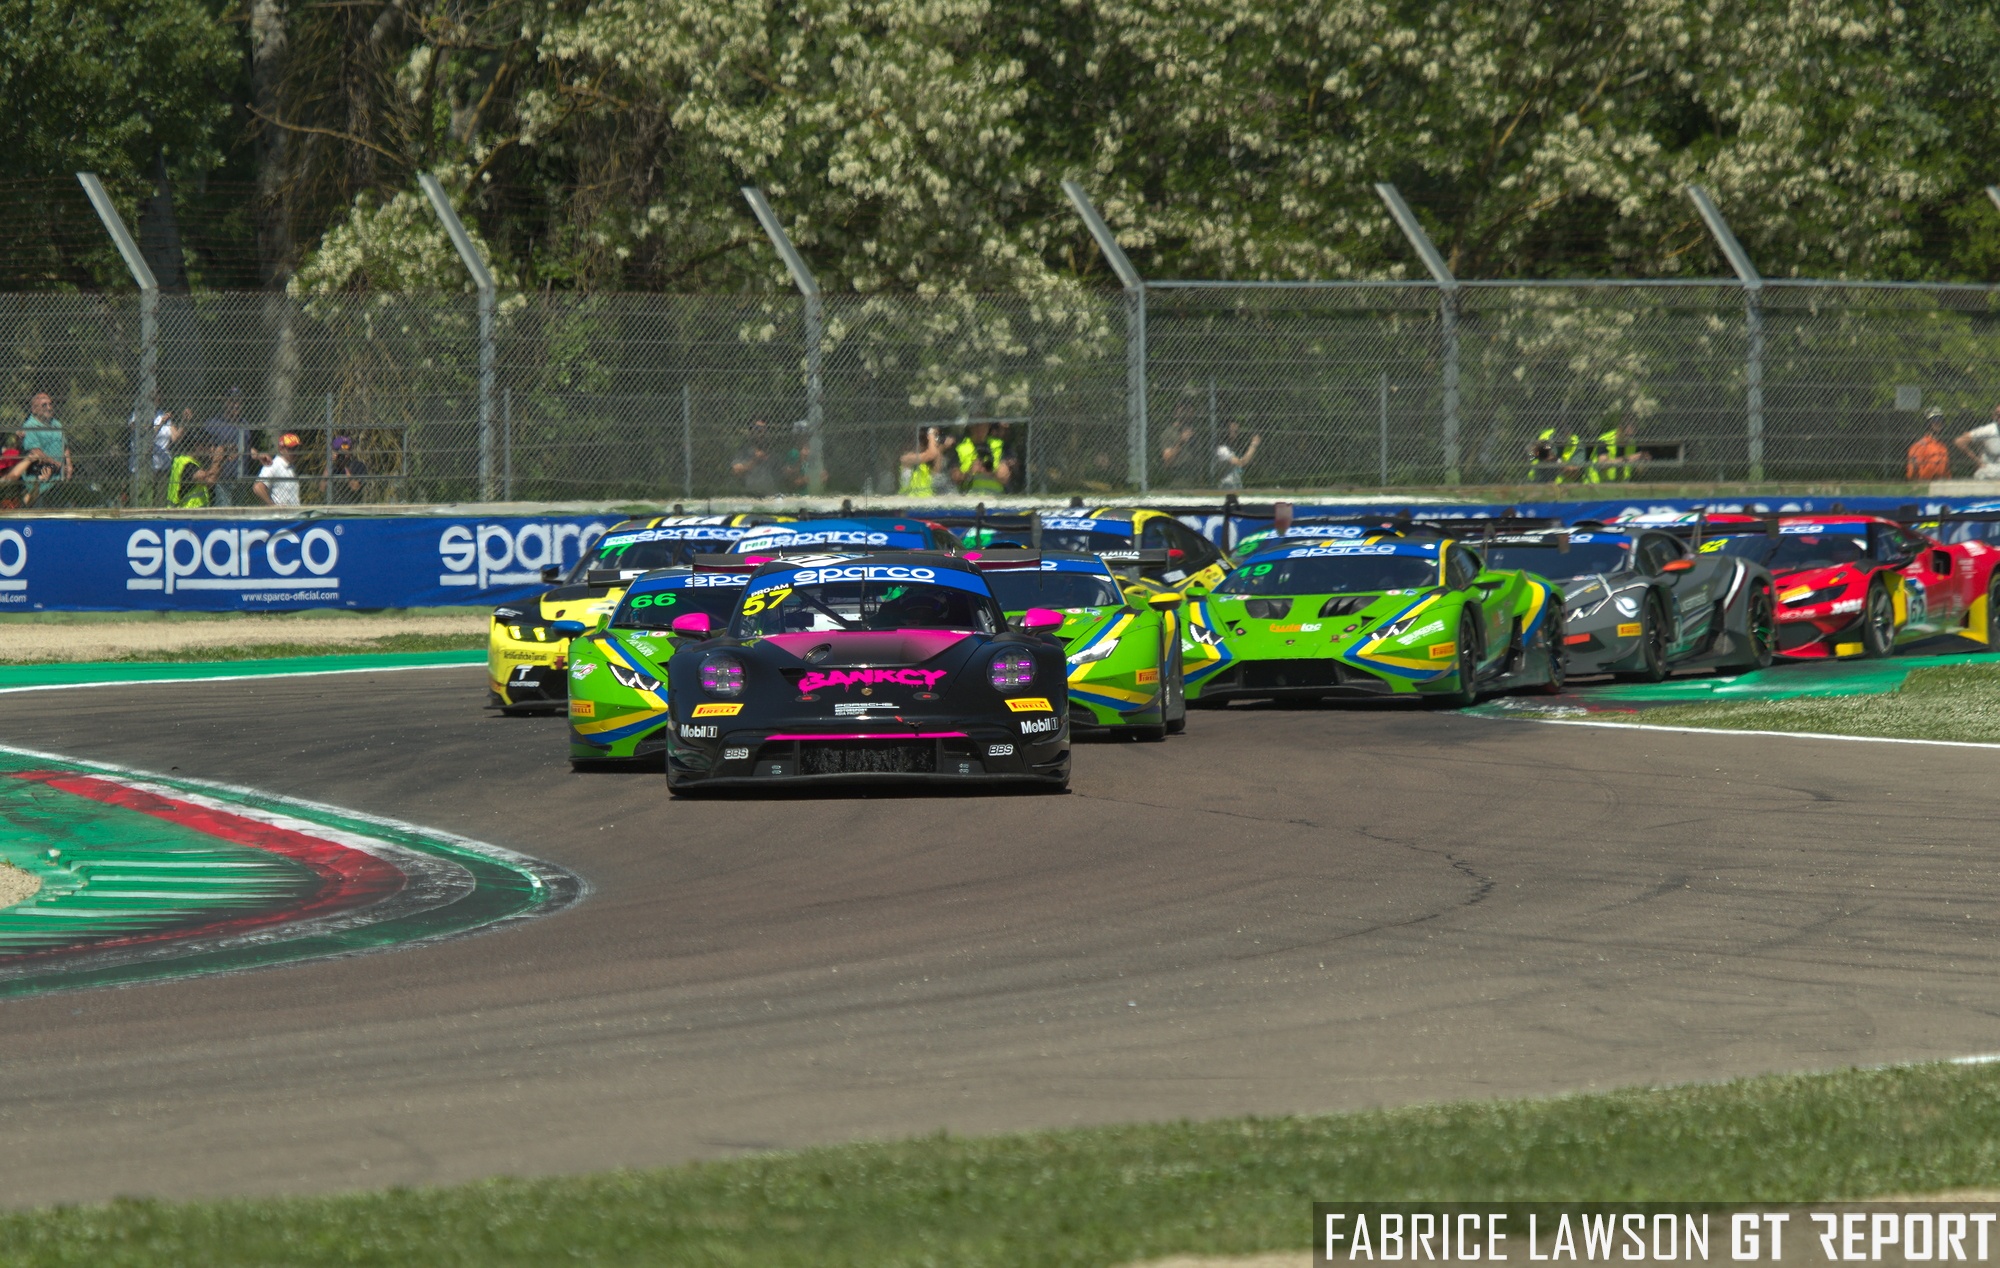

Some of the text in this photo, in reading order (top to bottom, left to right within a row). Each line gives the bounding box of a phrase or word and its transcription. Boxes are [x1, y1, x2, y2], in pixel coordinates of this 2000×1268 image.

[635, 528, 746, 541] sparco
[772, 531, 888, 547] sparco
[600, 543, 634, 559] 77
[1288, 543, 1397, 558] sparco
[127, 528, 338, 594] sparco
[793, 566, 936, 586] sparco
[1238, 563, 1274, 578] 19
[242, 591, 338, 603] www.sparco-official.com
[751, 583, 789, 598] PRO-AM
[630, 593, 677, 609] 66
[742, 588, 793, 616] 57
[798, 669, 947, 695] BANKCY
[698, 706, 737, 715] PIRELLI
[1011, 701, 1048, 710] PIRELLI
[680, 724, 707, 738] Mobil
[1020, 718, 1051, 734] Mobil
[724, 748, 749, 760] BBS
[988, 744, 1013, 756] BBS
